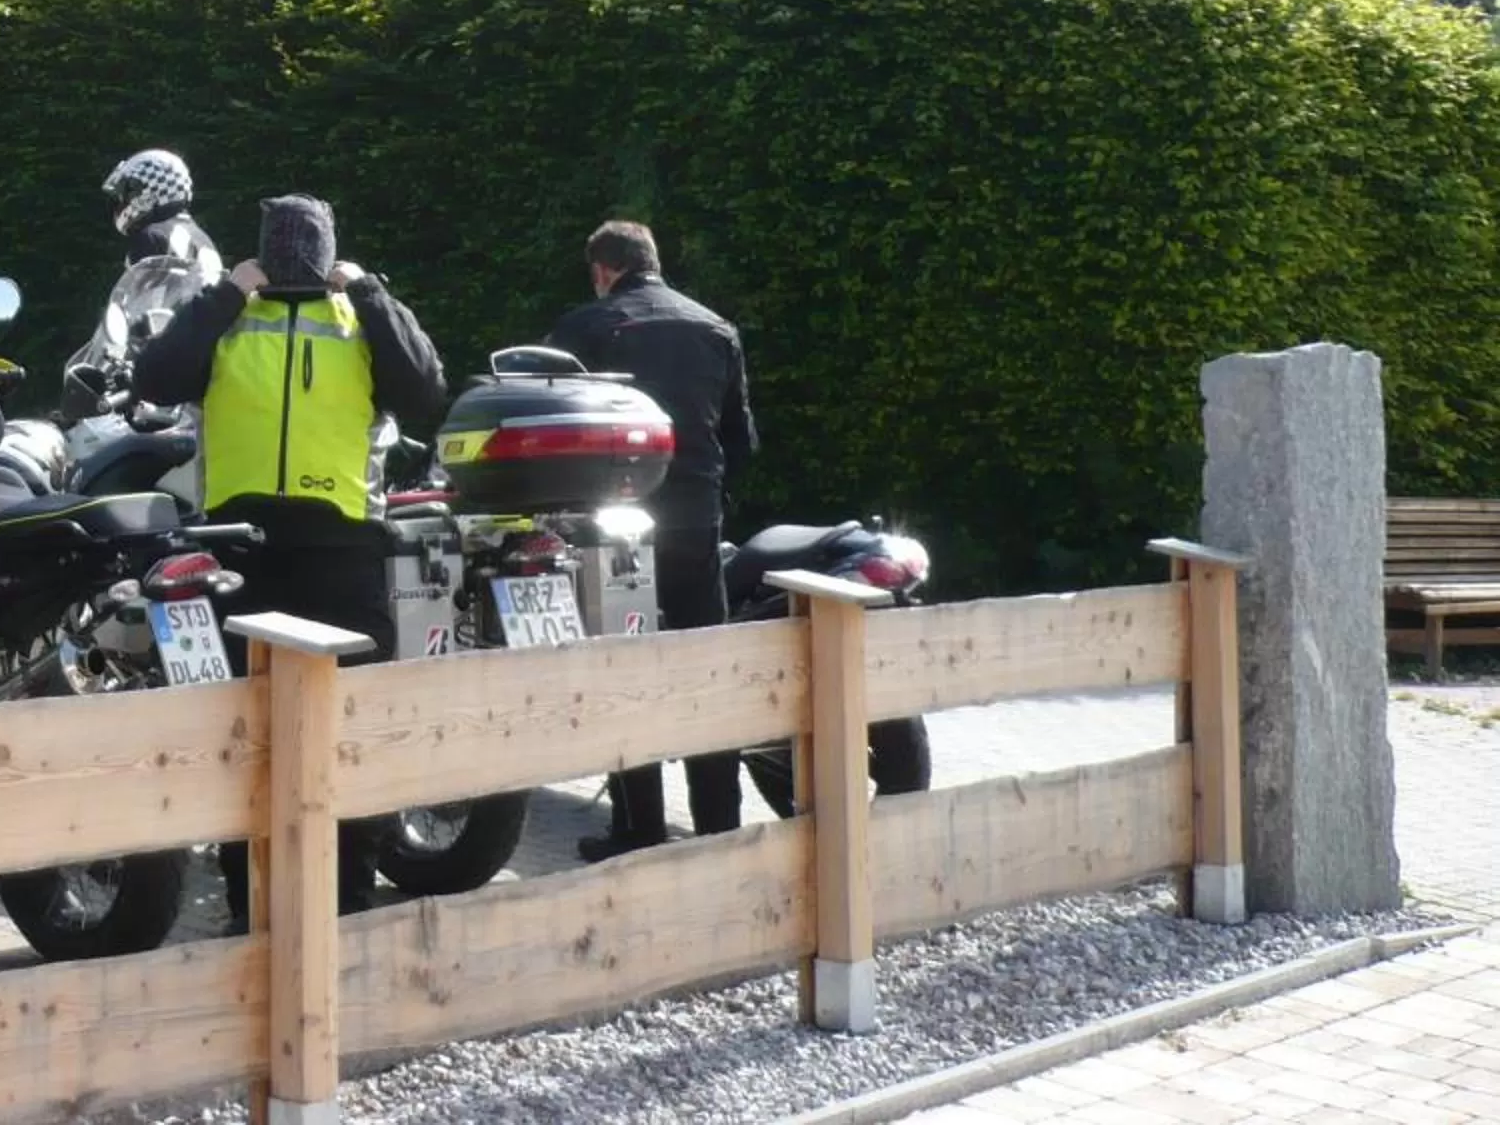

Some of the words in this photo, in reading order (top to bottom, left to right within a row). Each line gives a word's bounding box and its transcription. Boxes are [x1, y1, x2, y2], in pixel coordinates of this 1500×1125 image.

[508, 580, 561, 614] GRZ
[167, 603, 209, 629] STD
[171, 658, 201, 684] DL
[200, 655, 225, 682] 48
